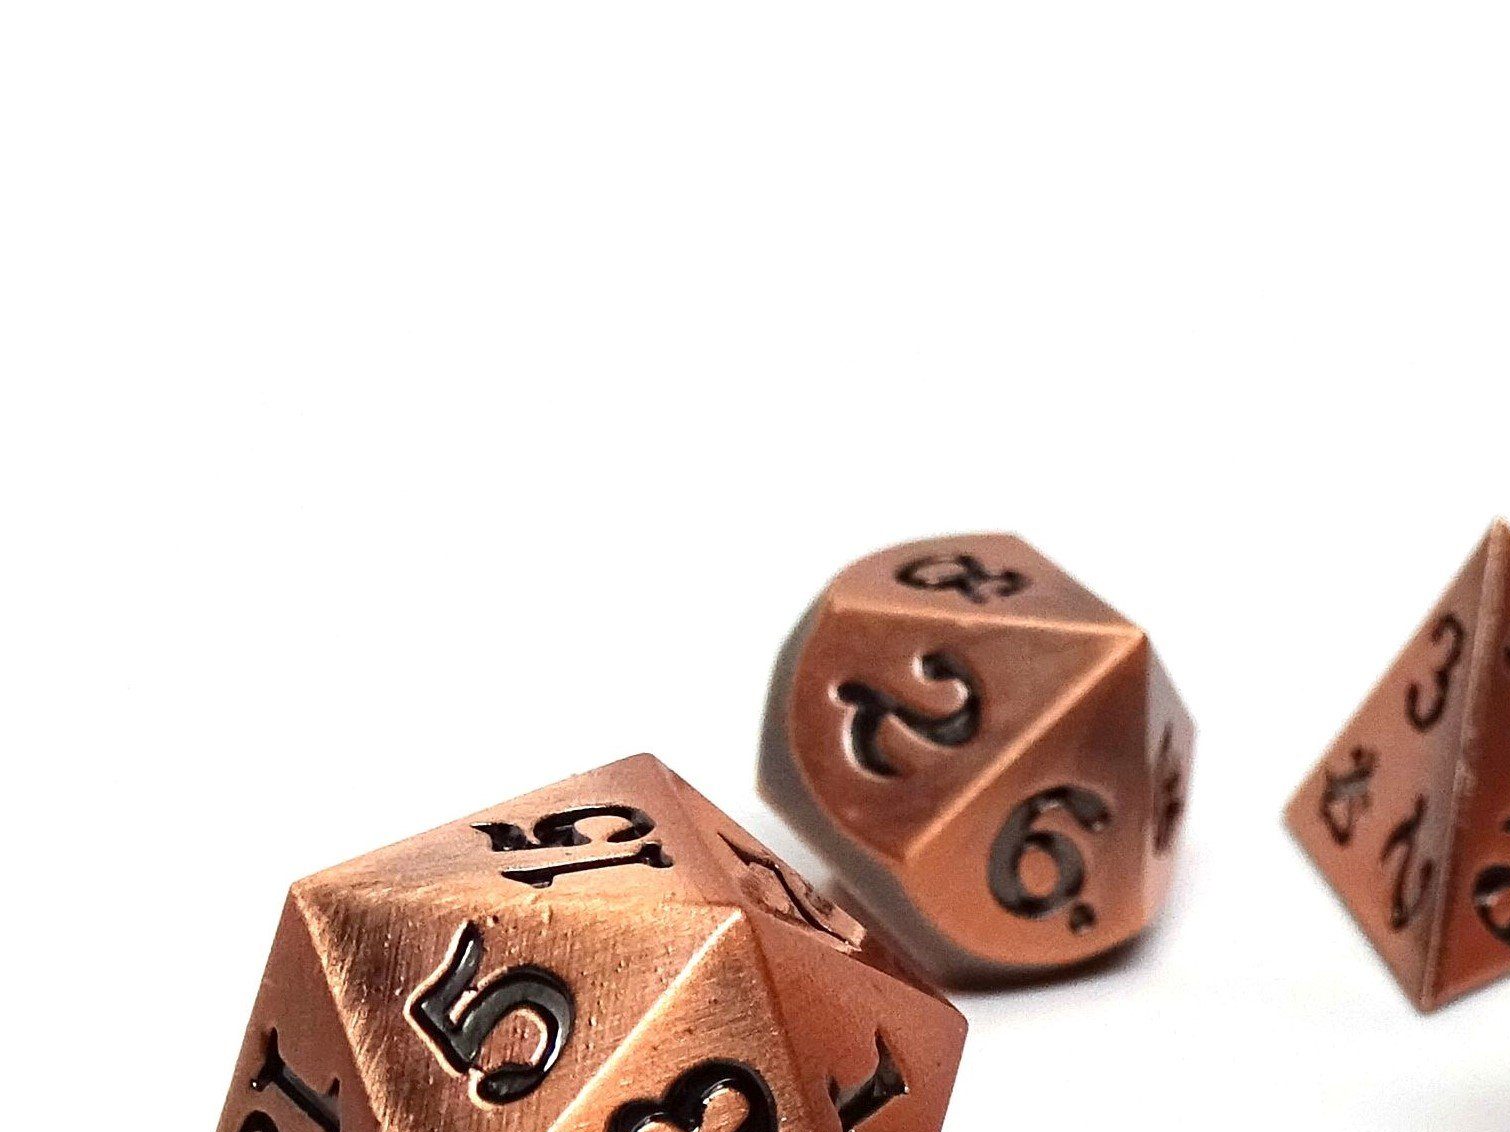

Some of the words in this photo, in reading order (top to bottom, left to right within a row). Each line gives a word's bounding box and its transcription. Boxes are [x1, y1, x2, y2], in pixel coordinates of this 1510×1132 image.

[829, 644, 983, 781] 2
[1405, 614, 1464, 734] 3
[470, 803, 676, 888] 15
[1381, 795, 1435, 932] 2
[405, 919, 578, 1106] 5
